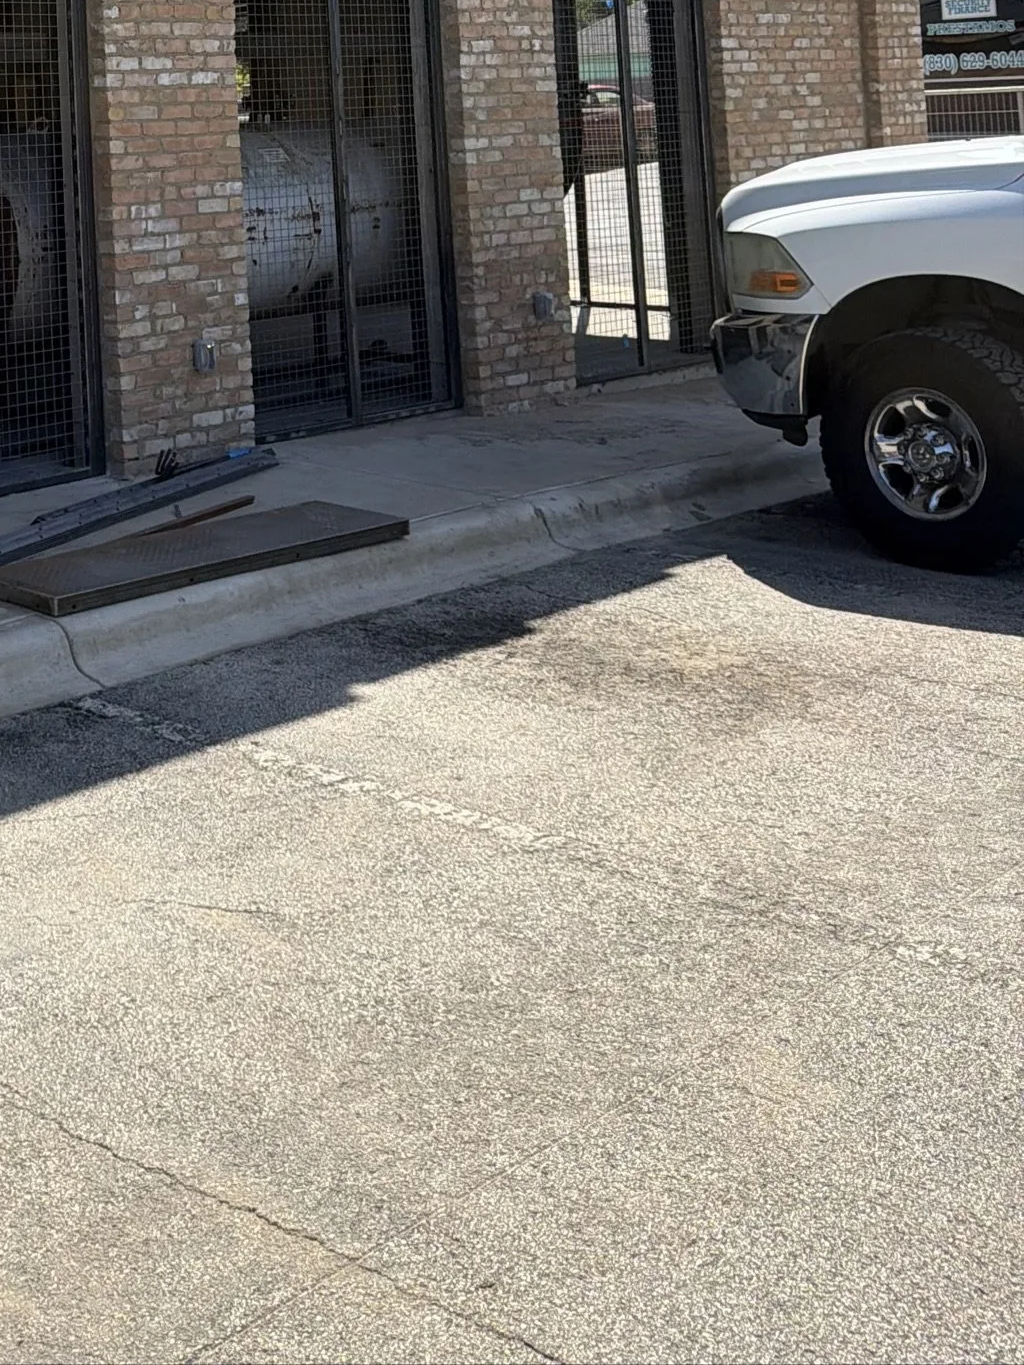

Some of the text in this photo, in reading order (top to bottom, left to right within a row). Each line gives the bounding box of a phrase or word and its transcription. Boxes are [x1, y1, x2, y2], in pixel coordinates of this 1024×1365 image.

[948, 5, 991, 15] FINANCE
[923, 50, 1024, 75] (830) 629-6044
